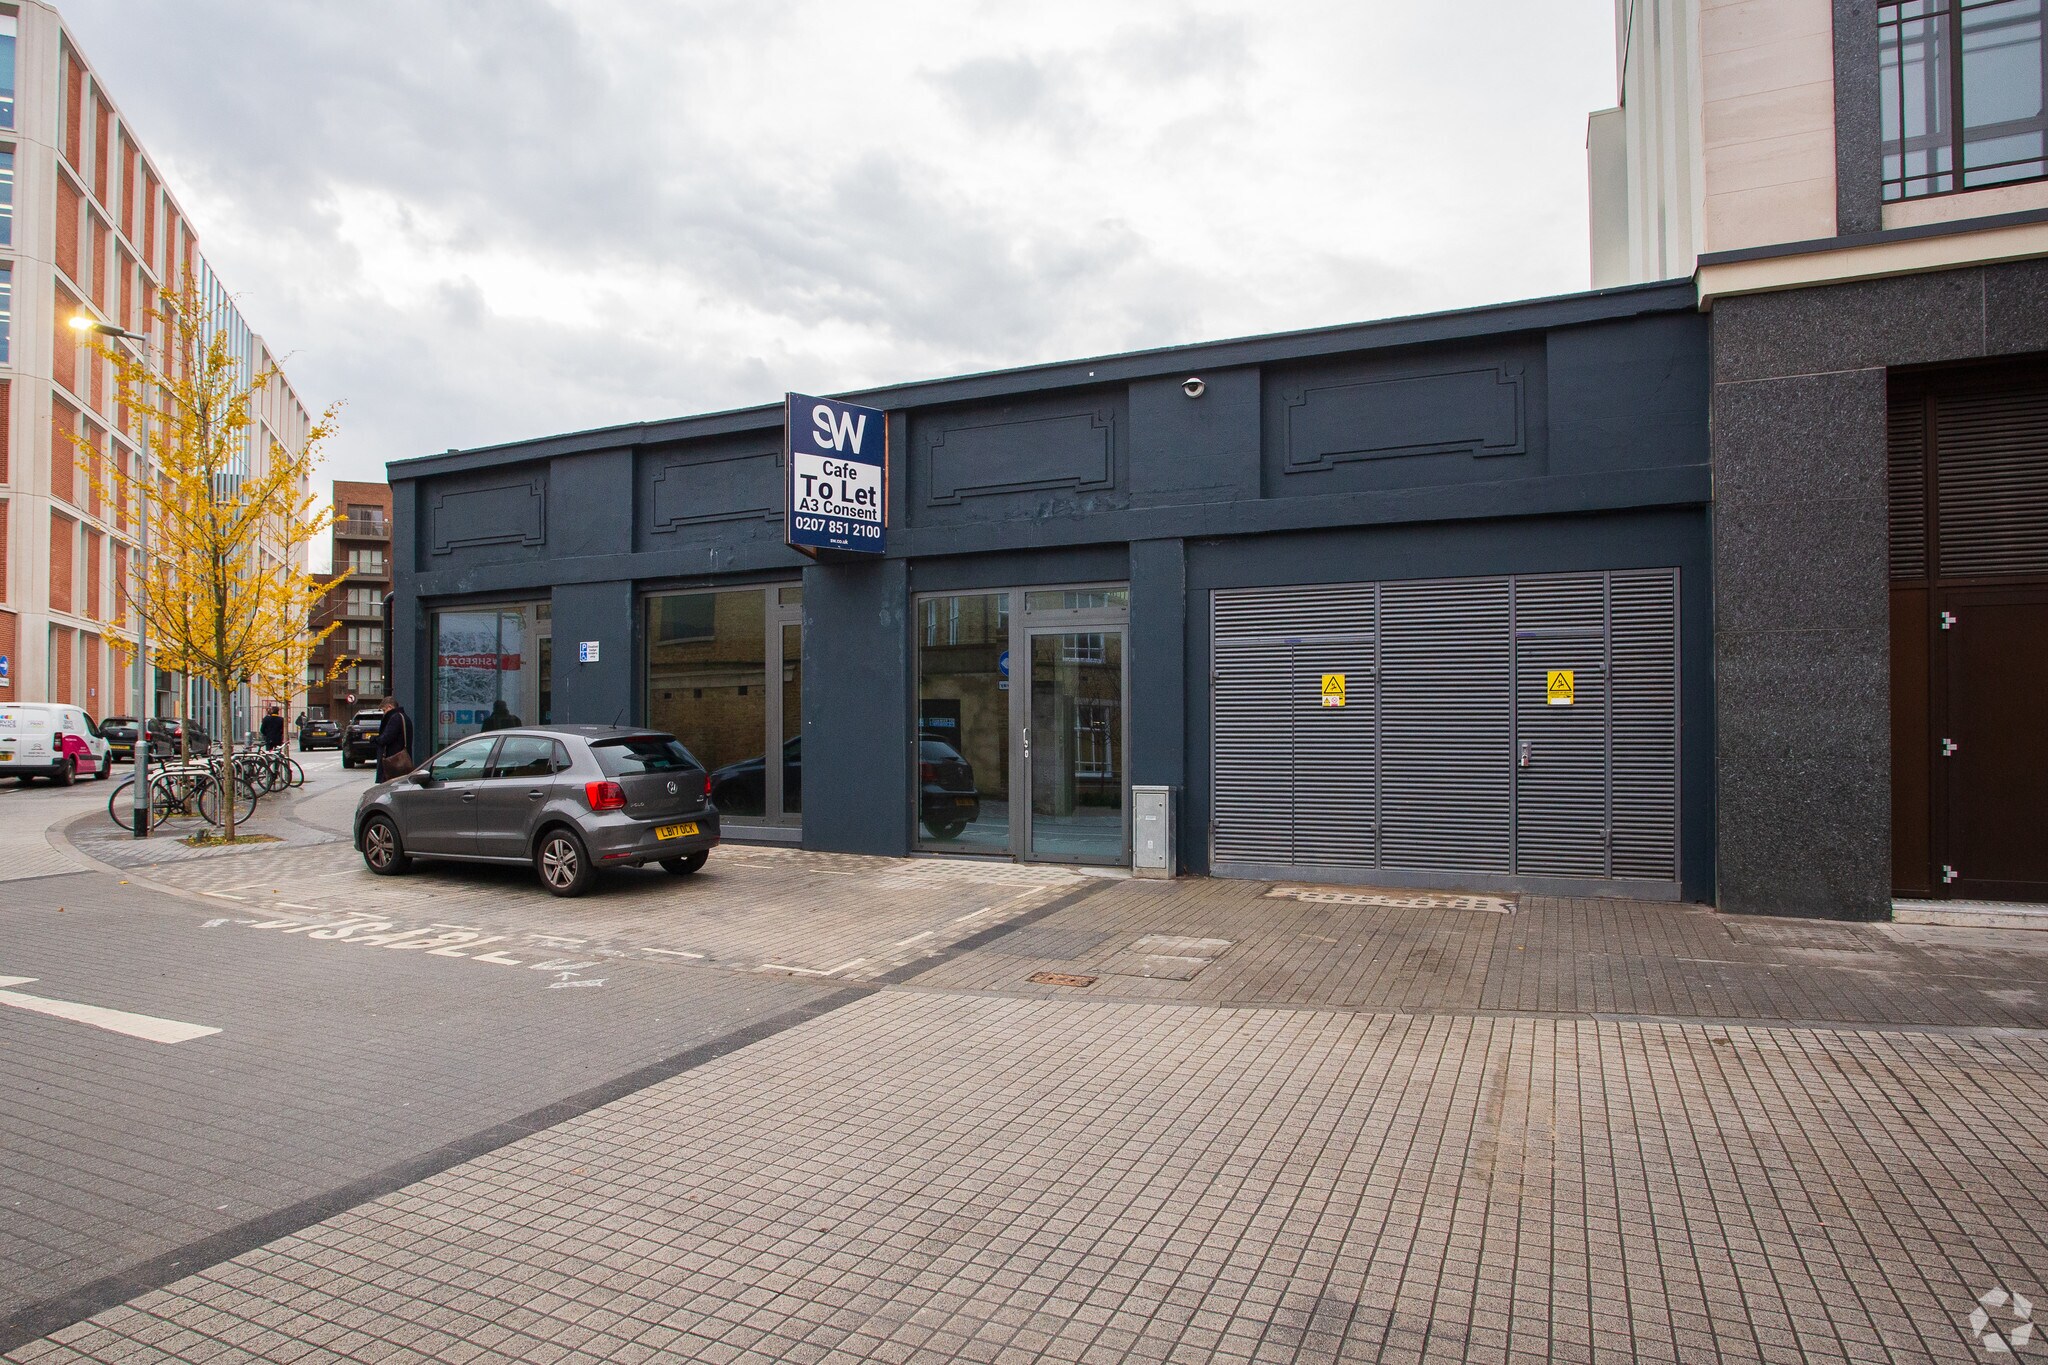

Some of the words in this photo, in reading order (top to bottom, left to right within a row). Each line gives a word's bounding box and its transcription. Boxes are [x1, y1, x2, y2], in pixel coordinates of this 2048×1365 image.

[812, 404, 867, 455] SW
[823, 460, 857, 480] Cafe
[800, 473, 833, 500] To
[841, 480, 877, 508] Let
[799, 497, 819, 512] A3
[823, 501, 877, 521] Consent
[795, 516, 825, 532] 0207
[828, 520, 849, 535] 851
[853, 523, 880, 539] 2100
[660, 825, 679, 837] LB17
[680, 823, 695, 835] OCK
